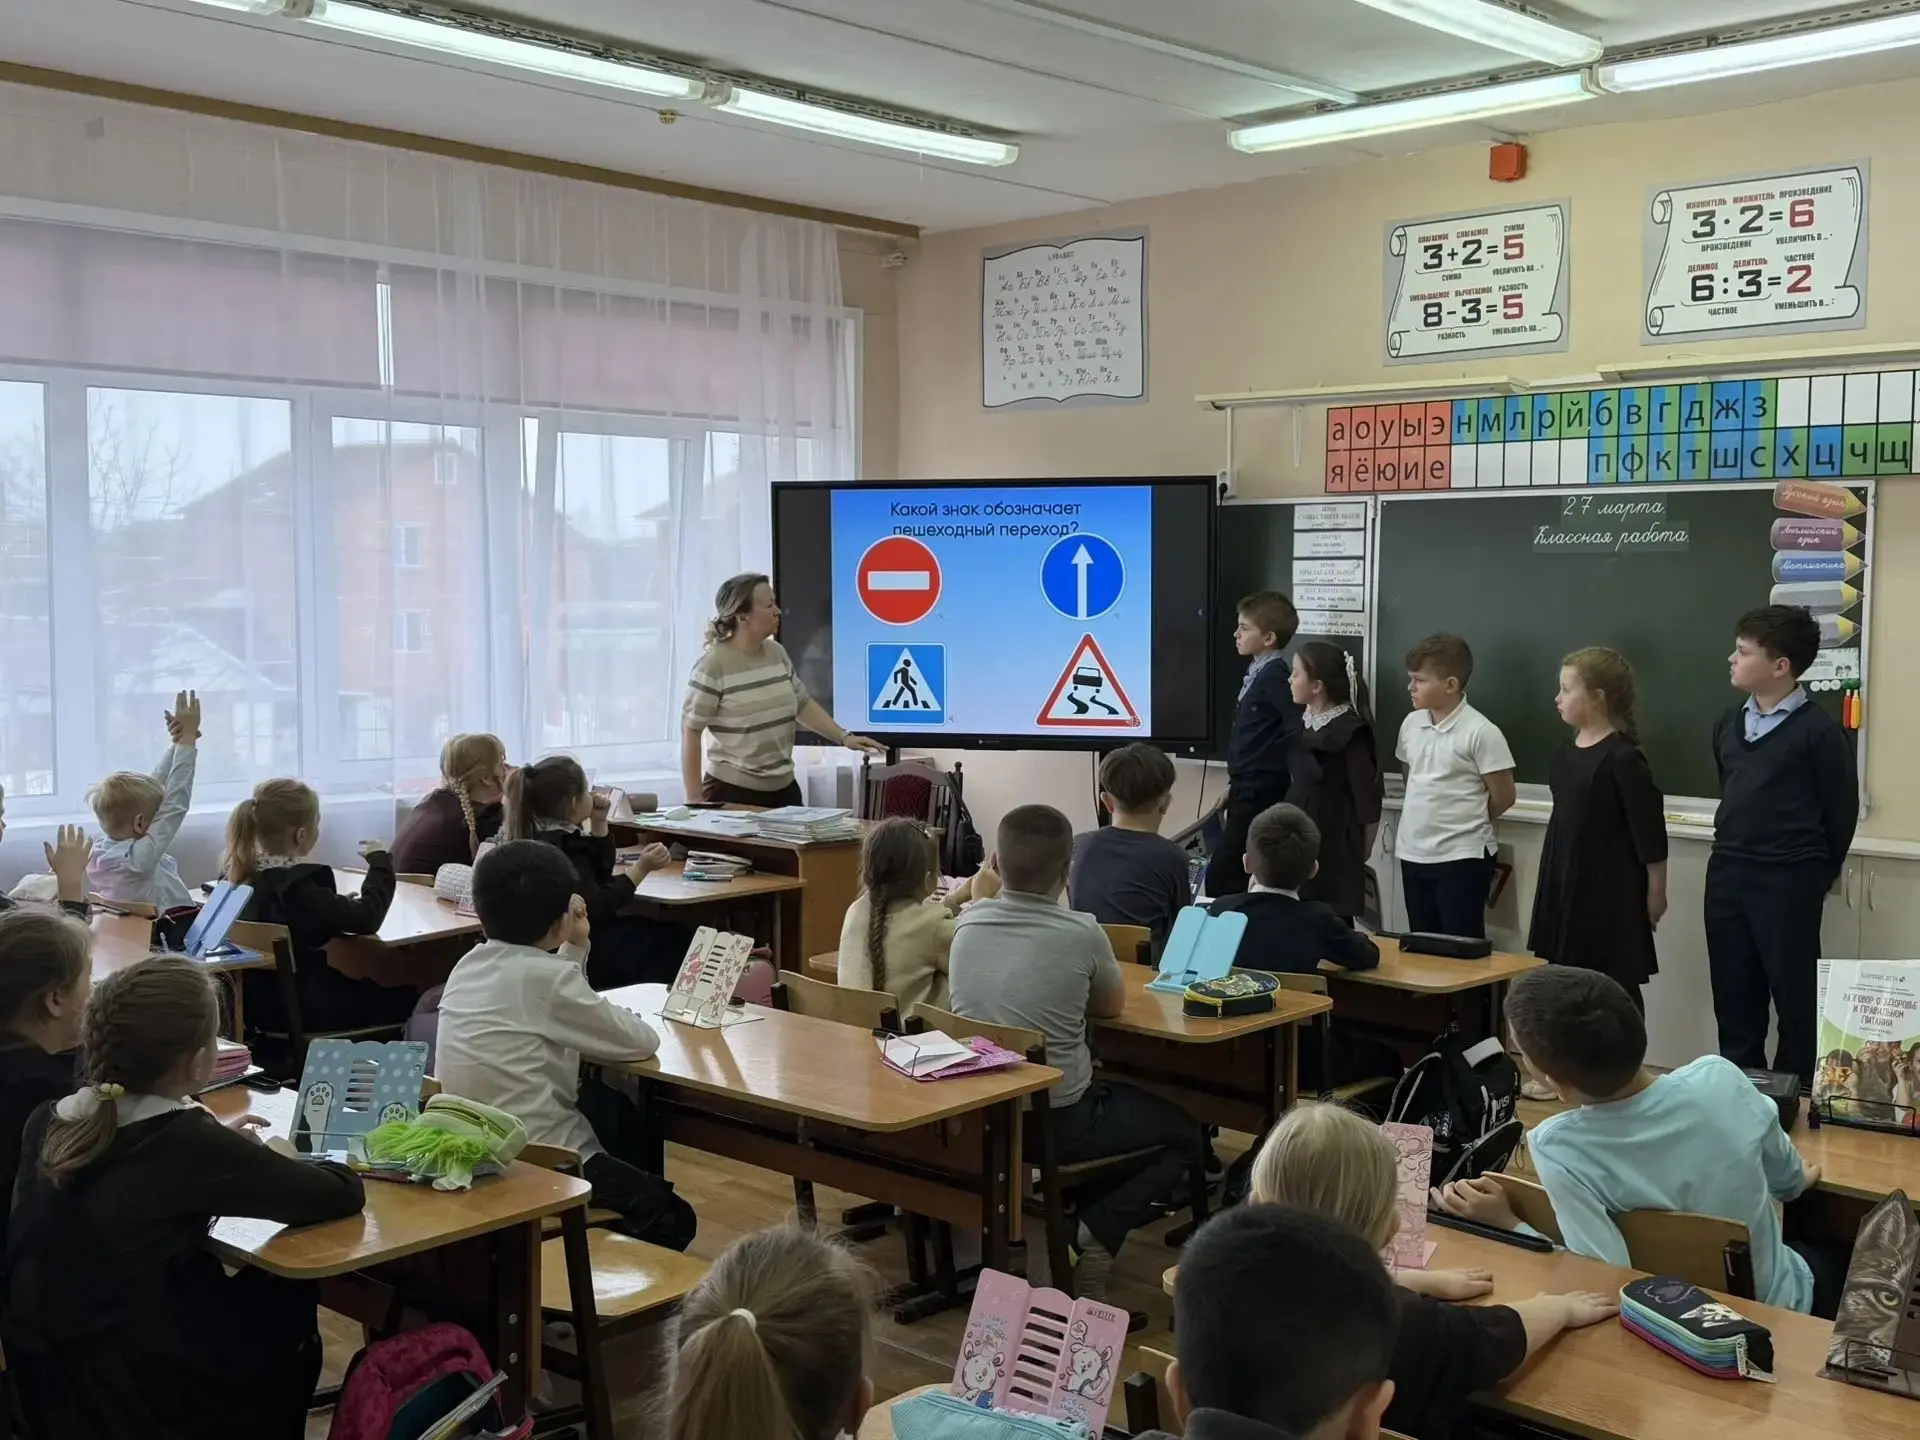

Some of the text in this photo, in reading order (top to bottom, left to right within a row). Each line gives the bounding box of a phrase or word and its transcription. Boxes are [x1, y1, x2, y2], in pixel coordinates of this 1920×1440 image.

[1686, 185, 1833, 209] МНОЖИТЕЛЬ МНОЖИТЕЛЬ ПРОИЗВЕДЕНИЕ
[1418, 223, 1525, 243] СЛАГАЕМОЕ СЛАГАЕМОЕ СУММА
[1776, 234, 1816, 245] УВЕЛИЧИТЬ
[1701, 239, 1752, 252] ПРОИЗВЕДЕНИЕ
[1687, 252, 1815, 273] ДЕЛИМОЕ ДЕЛИТЕЛЬ ЧАСТНОЕ
[1442, 273, 1462, 281] СУММА
[1493, 266, 1525, 276] УВЕЛИЧИТЬ
[1455, 286, 1493, 297] ВЫЧИТАЕМОЕ
[1498, 283, 1528, 292] РАЗНОСТЬ
[1708, 306, 1738, 316] ЧАСТНОЕ
[1775, 300, 1818, 310] УМЕНЬШИТЬ
[1438, 331, 1466, 340] РАЗНОСТЬ
[1492, 326, 1528, 335] УМЕНЬШИТЬ
[890, 501, 1082, 516] Какой знак обозначает
[1563, 496, 1593, 515] 27
[893, 520, 1080, 539] пешеходный переход?
[1533, 525, 1613, 544] Классная
[1780, 559, 1846, 570] Математика
